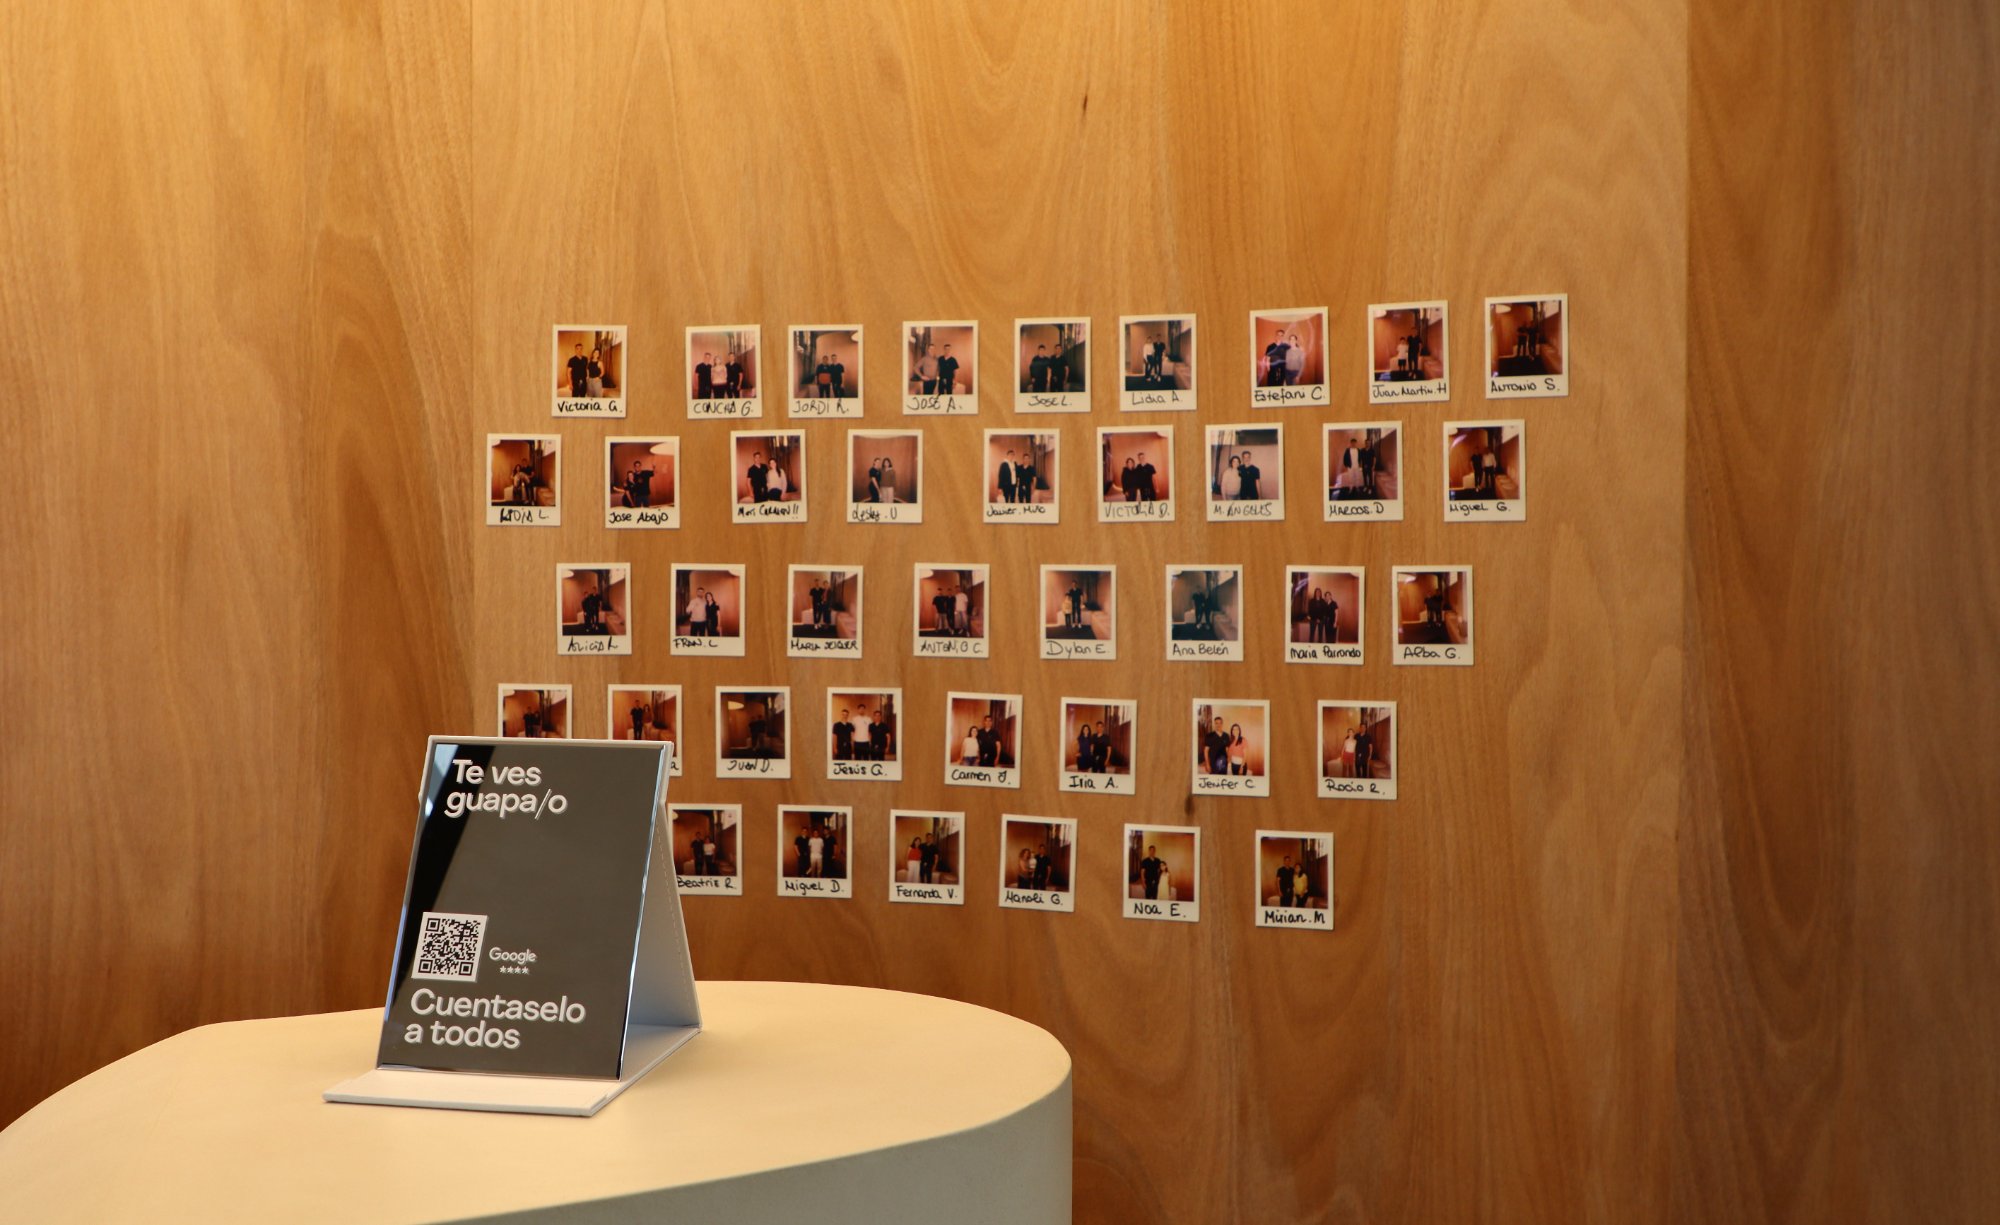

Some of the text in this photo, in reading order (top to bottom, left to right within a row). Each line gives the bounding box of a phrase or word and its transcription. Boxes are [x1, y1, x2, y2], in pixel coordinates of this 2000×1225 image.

[946, 396, 962, 413] A.
[636, 509, 669, 525] Abajo
[1173, 643, 1195, 656] Ana
[1445, 647, 1461, 659] G.
[453, 759, 542, 786] Te ves
[952, 769, 991, 782] Carmen
[1105, 777, 1118, 788] A.
[444, 788, 568, 820] guapa/o
[1134, 903, 1186, 918] Noa E.
[1314, 911, 1325, 924] M
[489, 947, 537, 964] Google
[410, 988, 586, 1023] Cuentaselo
[404, 1020, 521, 1050] a todos
